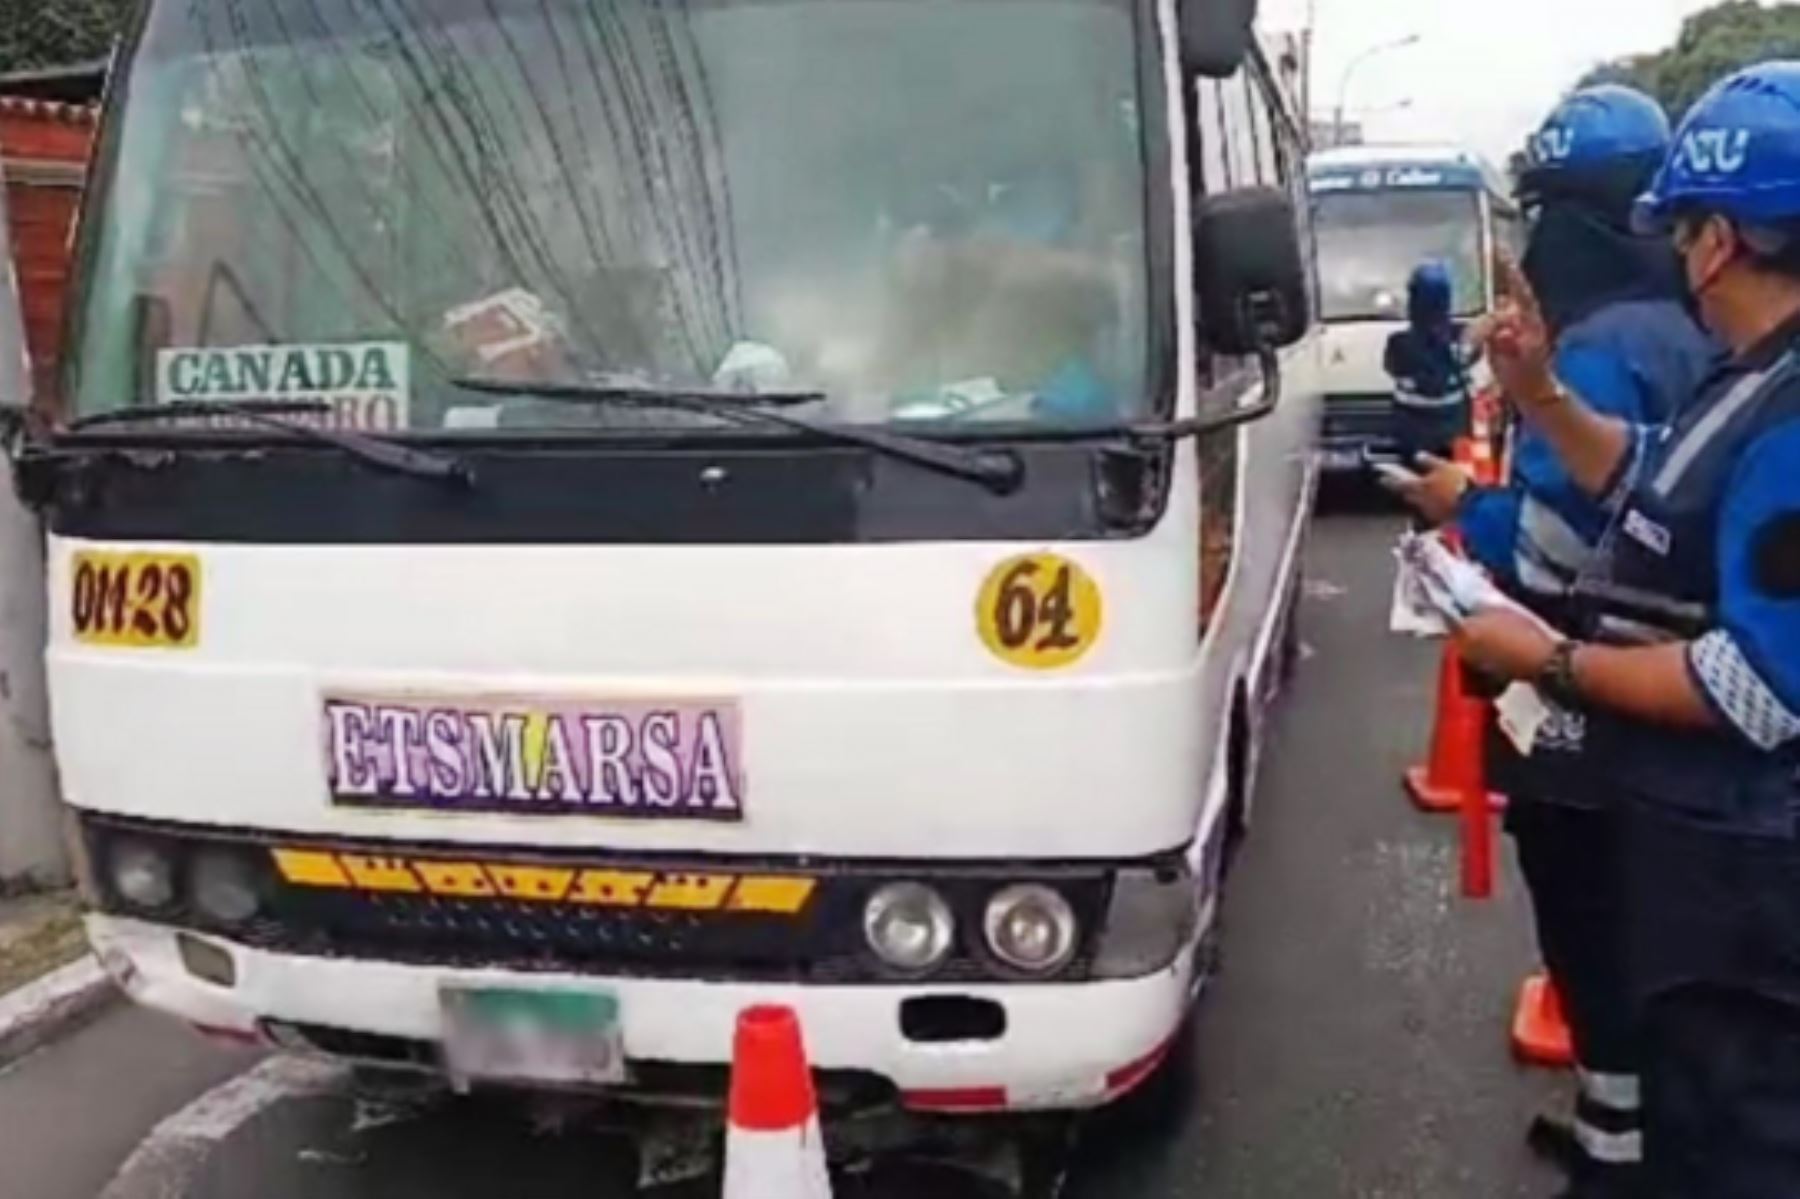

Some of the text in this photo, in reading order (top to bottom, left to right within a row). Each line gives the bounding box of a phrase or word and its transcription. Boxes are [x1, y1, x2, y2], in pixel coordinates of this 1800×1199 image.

[167, 347, 397, 394] CANADA
[994, 559, 1079, 653] 64
[327, 704, 739, 809] ETSMARSA
